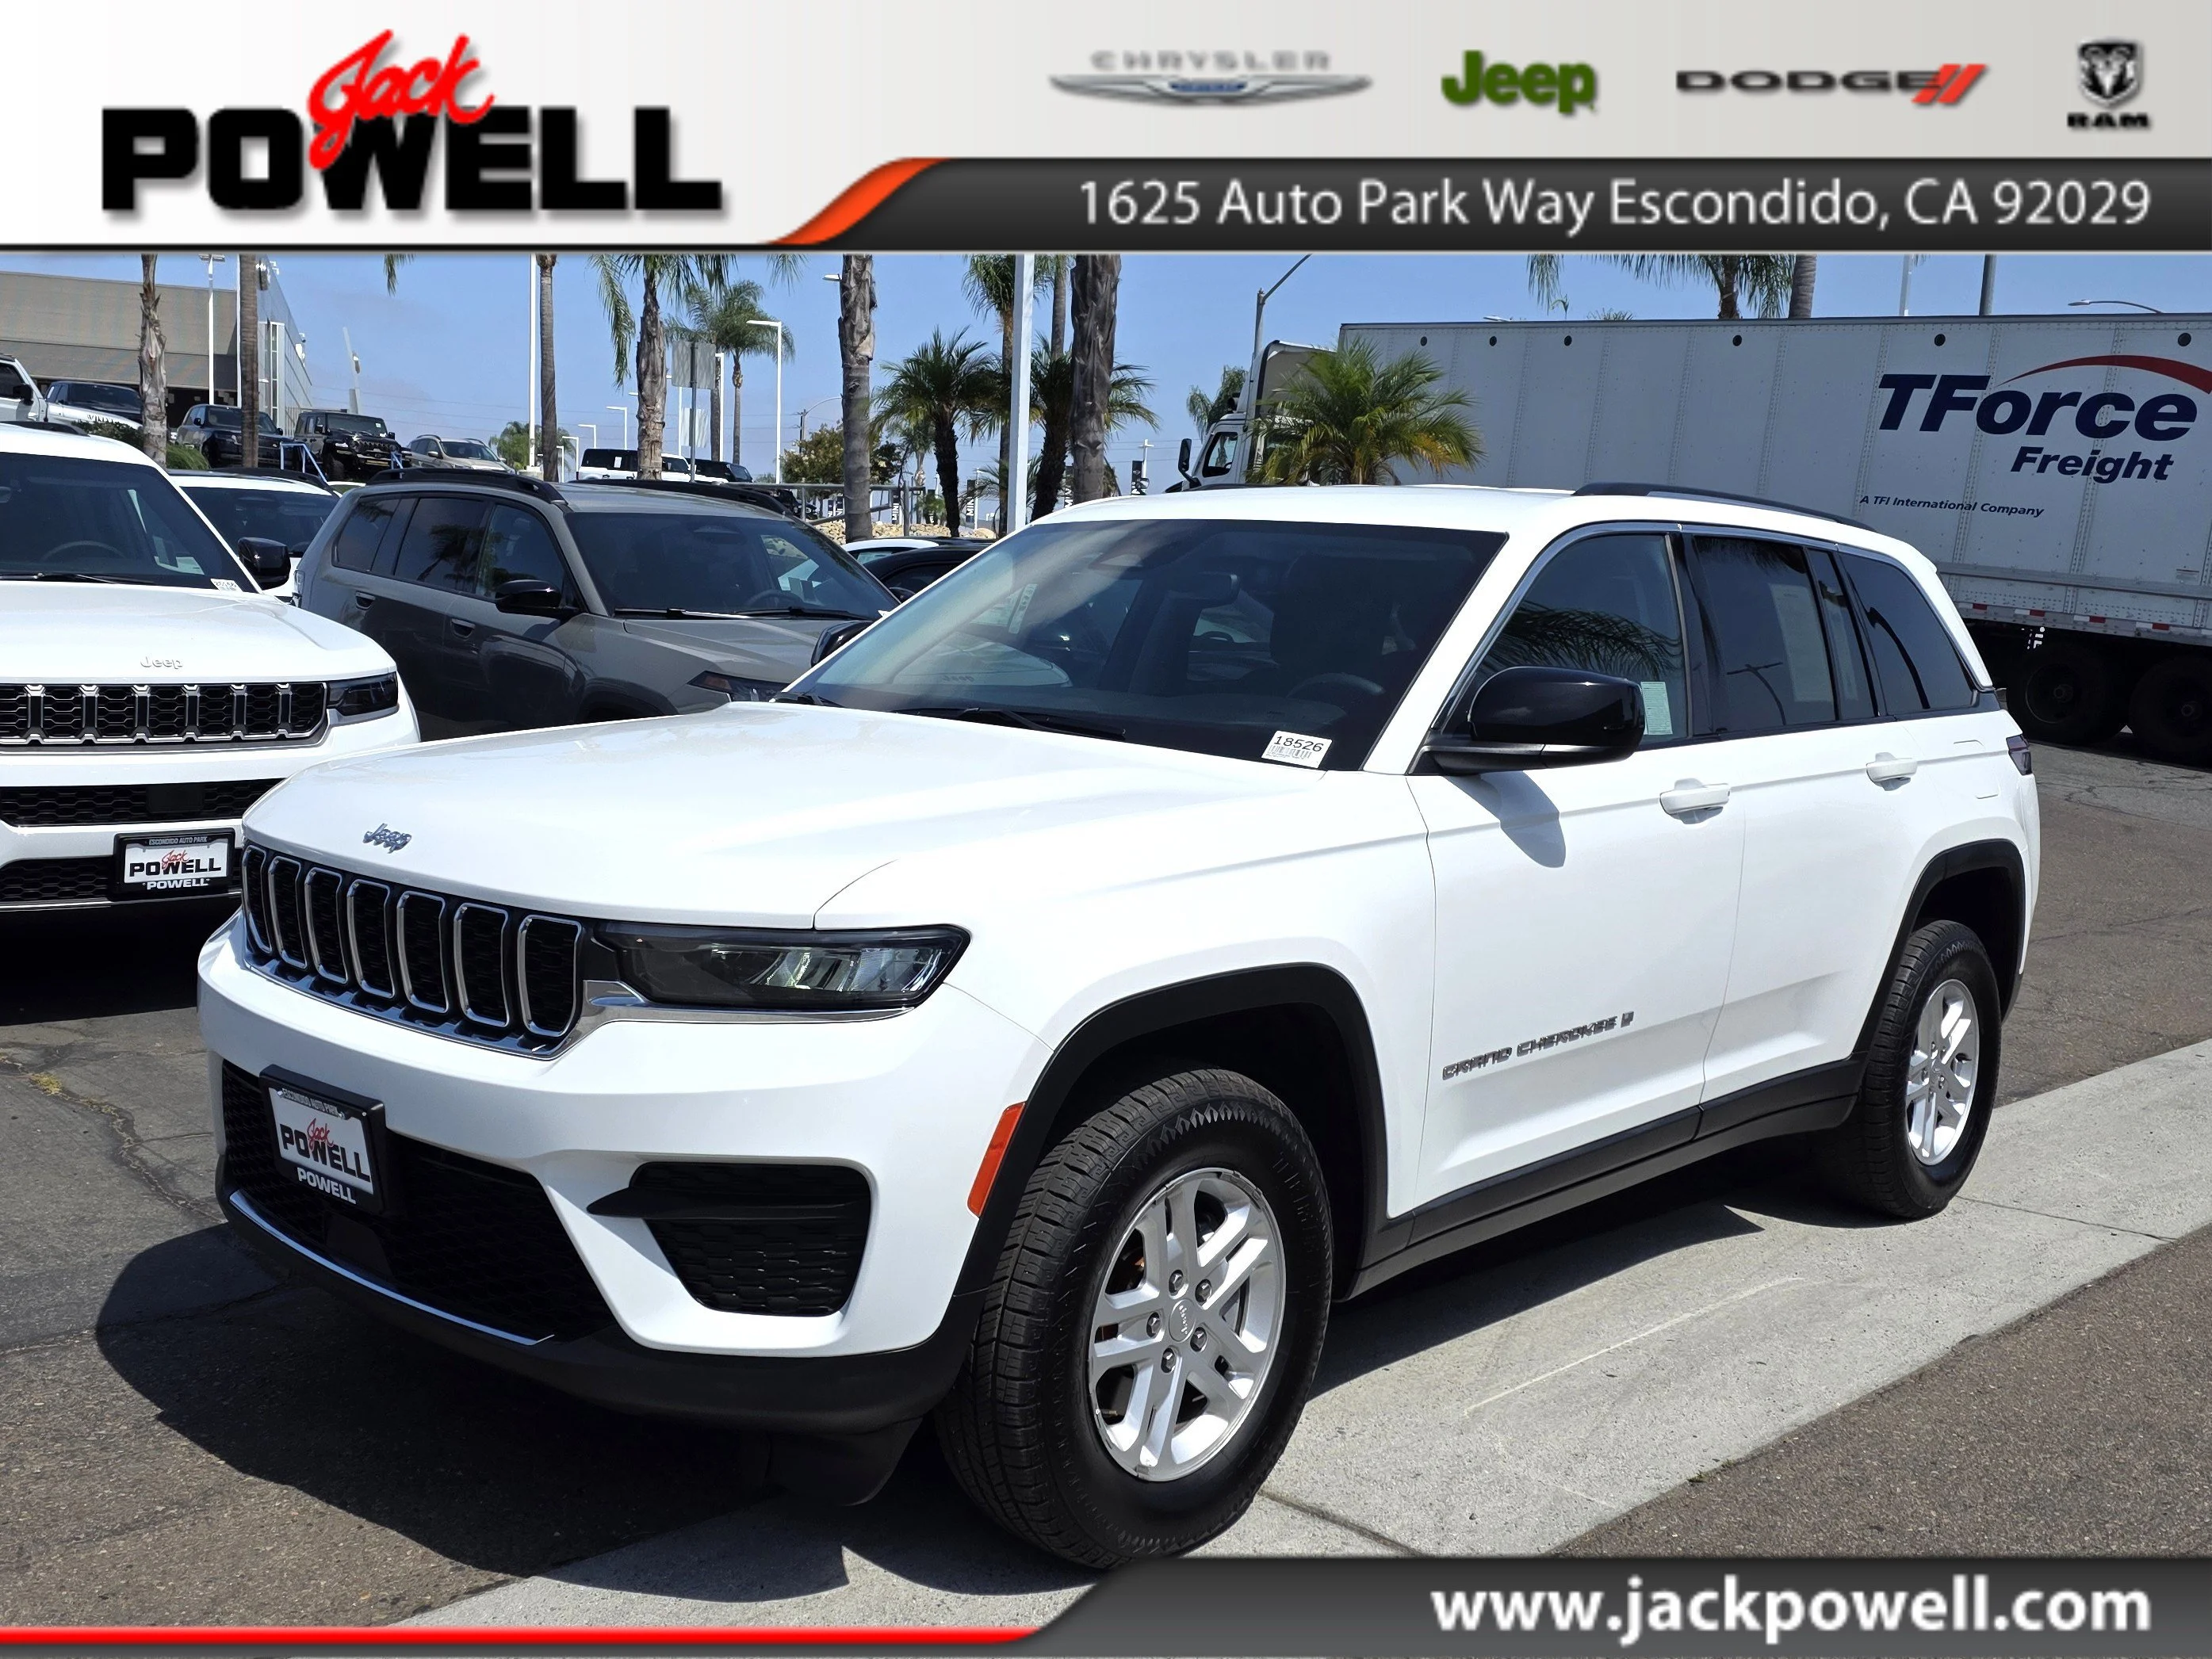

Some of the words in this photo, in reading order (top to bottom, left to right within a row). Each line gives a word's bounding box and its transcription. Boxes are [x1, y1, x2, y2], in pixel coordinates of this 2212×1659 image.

[1878, 373, 2198, 442] TForce
[2010, 445, 2174, 484] Freight
[1859, 495, 1869, 505] A
[1873, 496, 1891, 506] TFI
[1892, 497, 1977, 512] International
[1980, 503, 2046, 518] Company
[140, 654, 182, 670] Jeep
[1273, 736, 1325, 752] 18526
[362, 823, 412, 854] Jeep
[129, 858, 222, 877] POWELL
[161, 849, 189, 870] Jack
[147, 877, 209, 890] POWELL
[1442, 1046, 1513, 1081] GRAND
[1517, 1015, 1618, 1057] CHEROKEE
[307, 1118, 335, 1152] Jack
[279, 1123, 371, 1183] POWELL
[297, 1166, 357, 1205] POWELL
